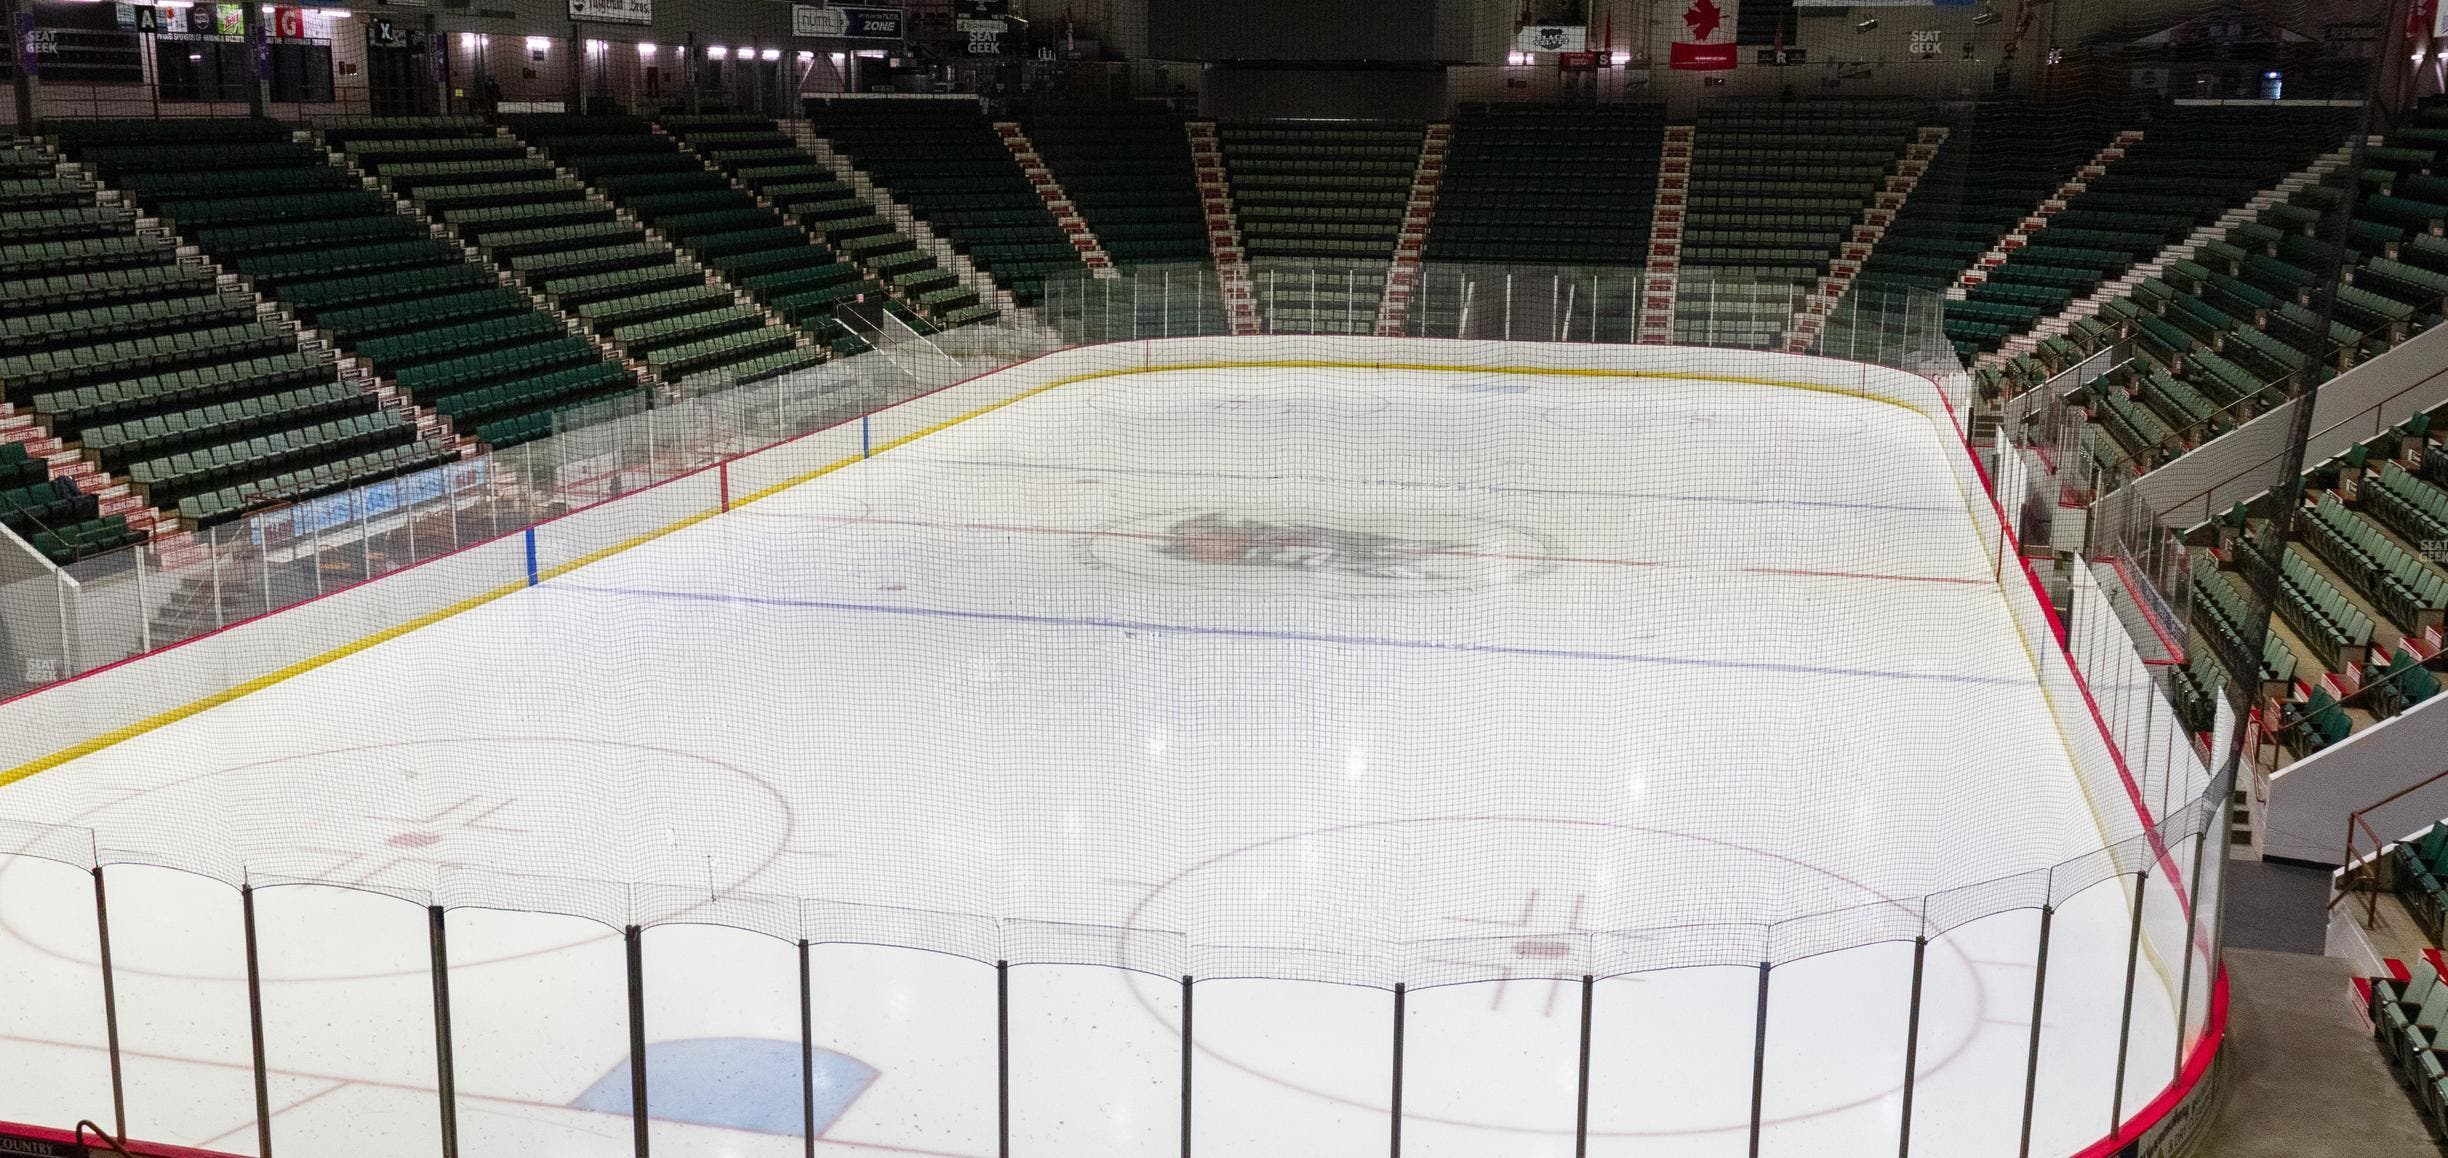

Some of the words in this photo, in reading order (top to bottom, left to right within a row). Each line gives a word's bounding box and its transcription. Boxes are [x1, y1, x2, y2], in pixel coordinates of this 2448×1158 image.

[281, 10, 296, 36] G
[863, 20, 896, 31] ZONE
[1599, 54, 1608, 65] S
